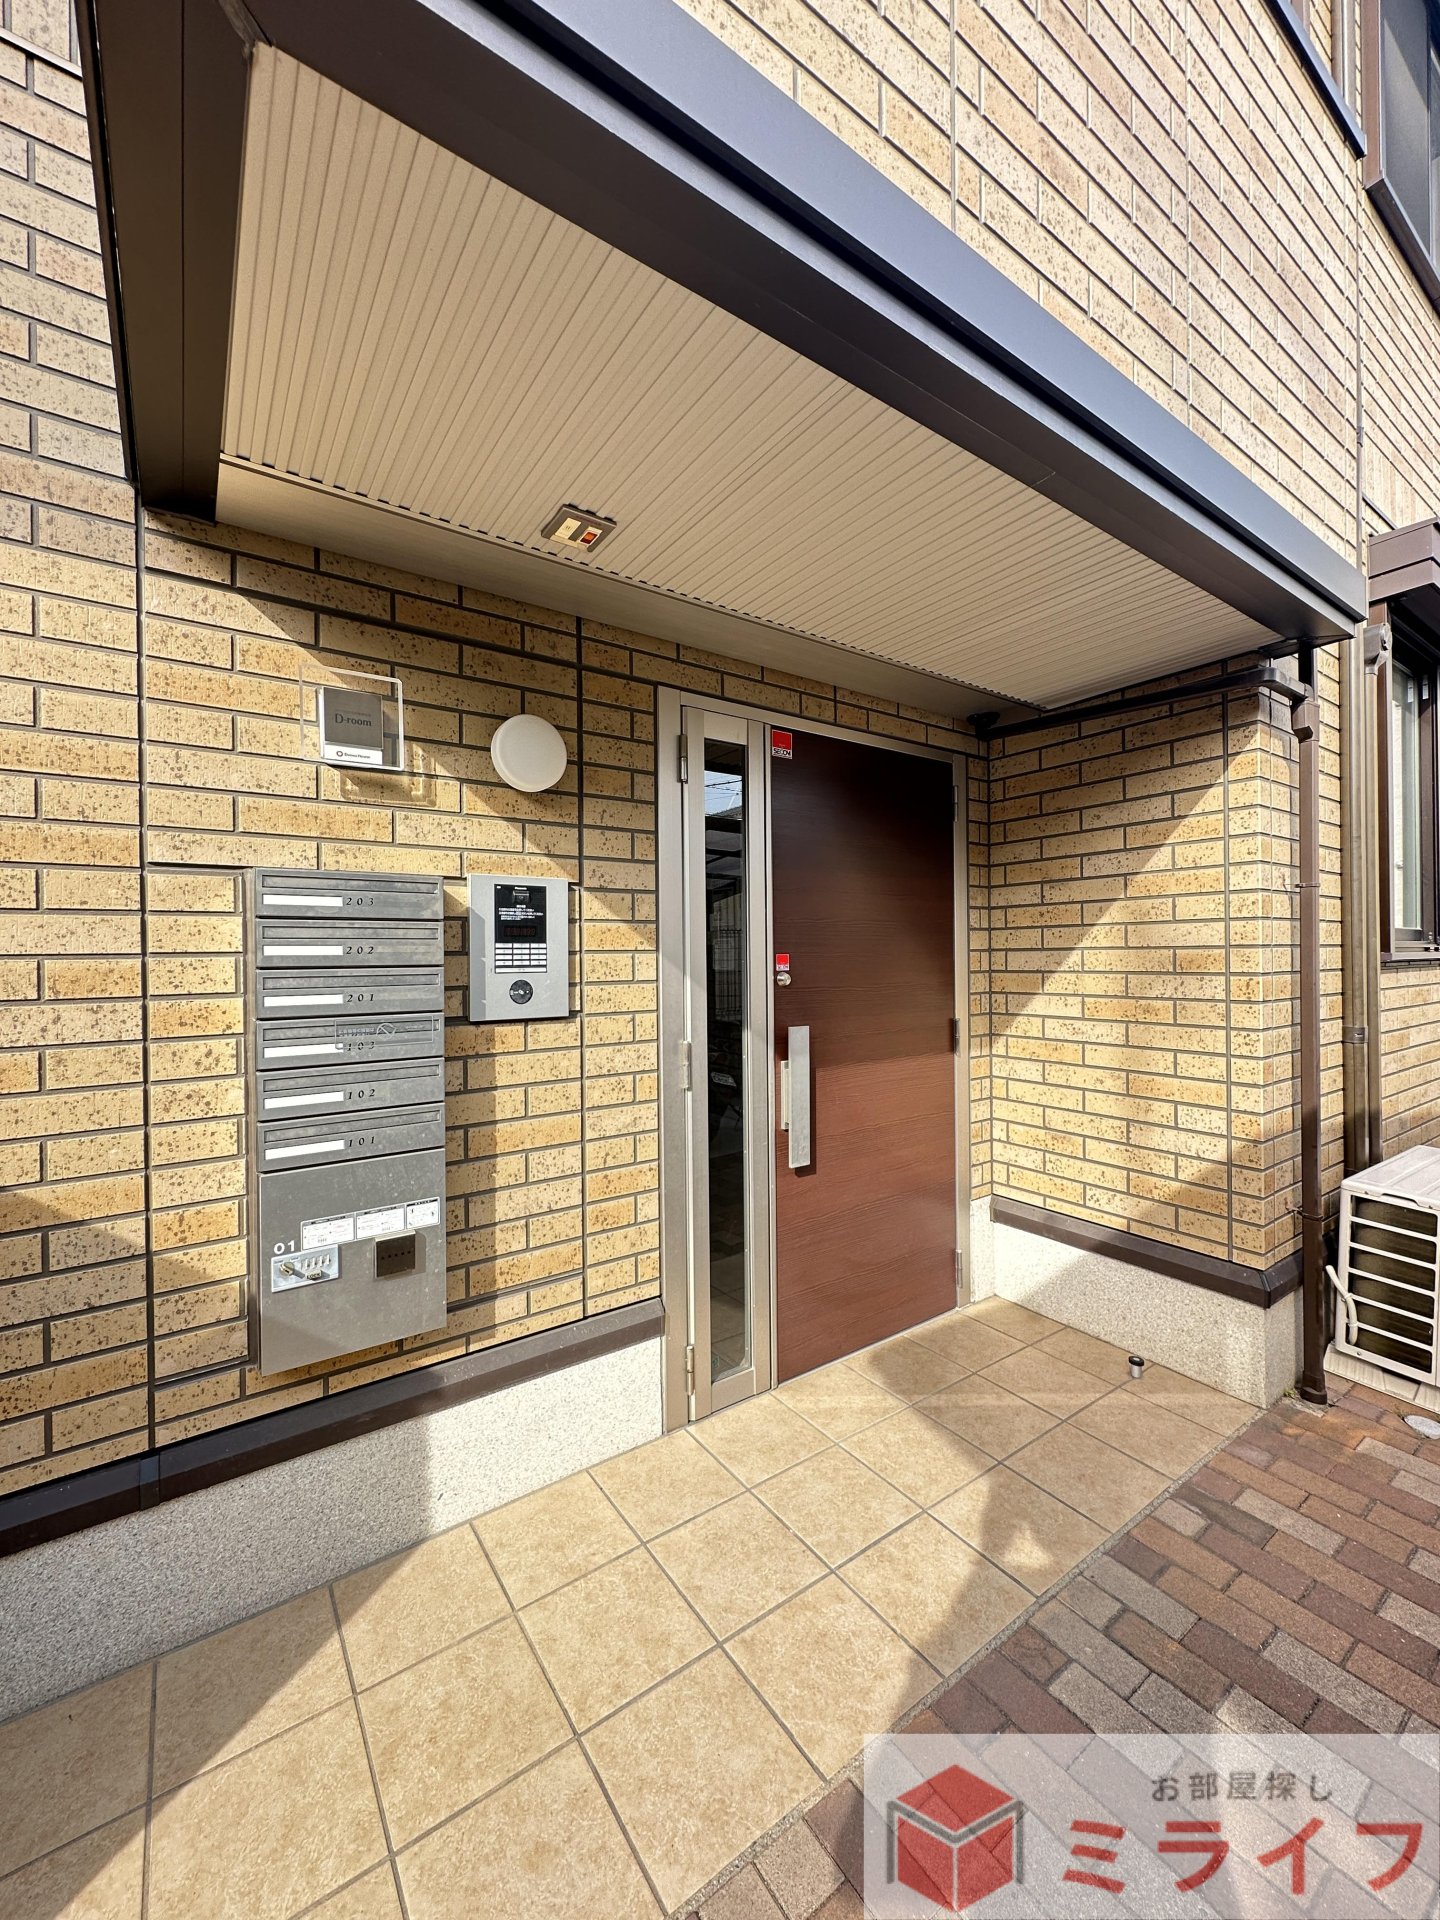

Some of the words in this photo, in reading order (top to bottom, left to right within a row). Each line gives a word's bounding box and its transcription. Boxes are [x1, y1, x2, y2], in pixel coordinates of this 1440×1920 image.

[346, 896, 375, 907] 203
[346, 945, 375, 955] 202
[347, 993, 375, 1003] 201
[347, 1041, 376, 1052] 103
[348, 1088, 376, 1100] 102
[348, 1136, 376, 1148] 101
